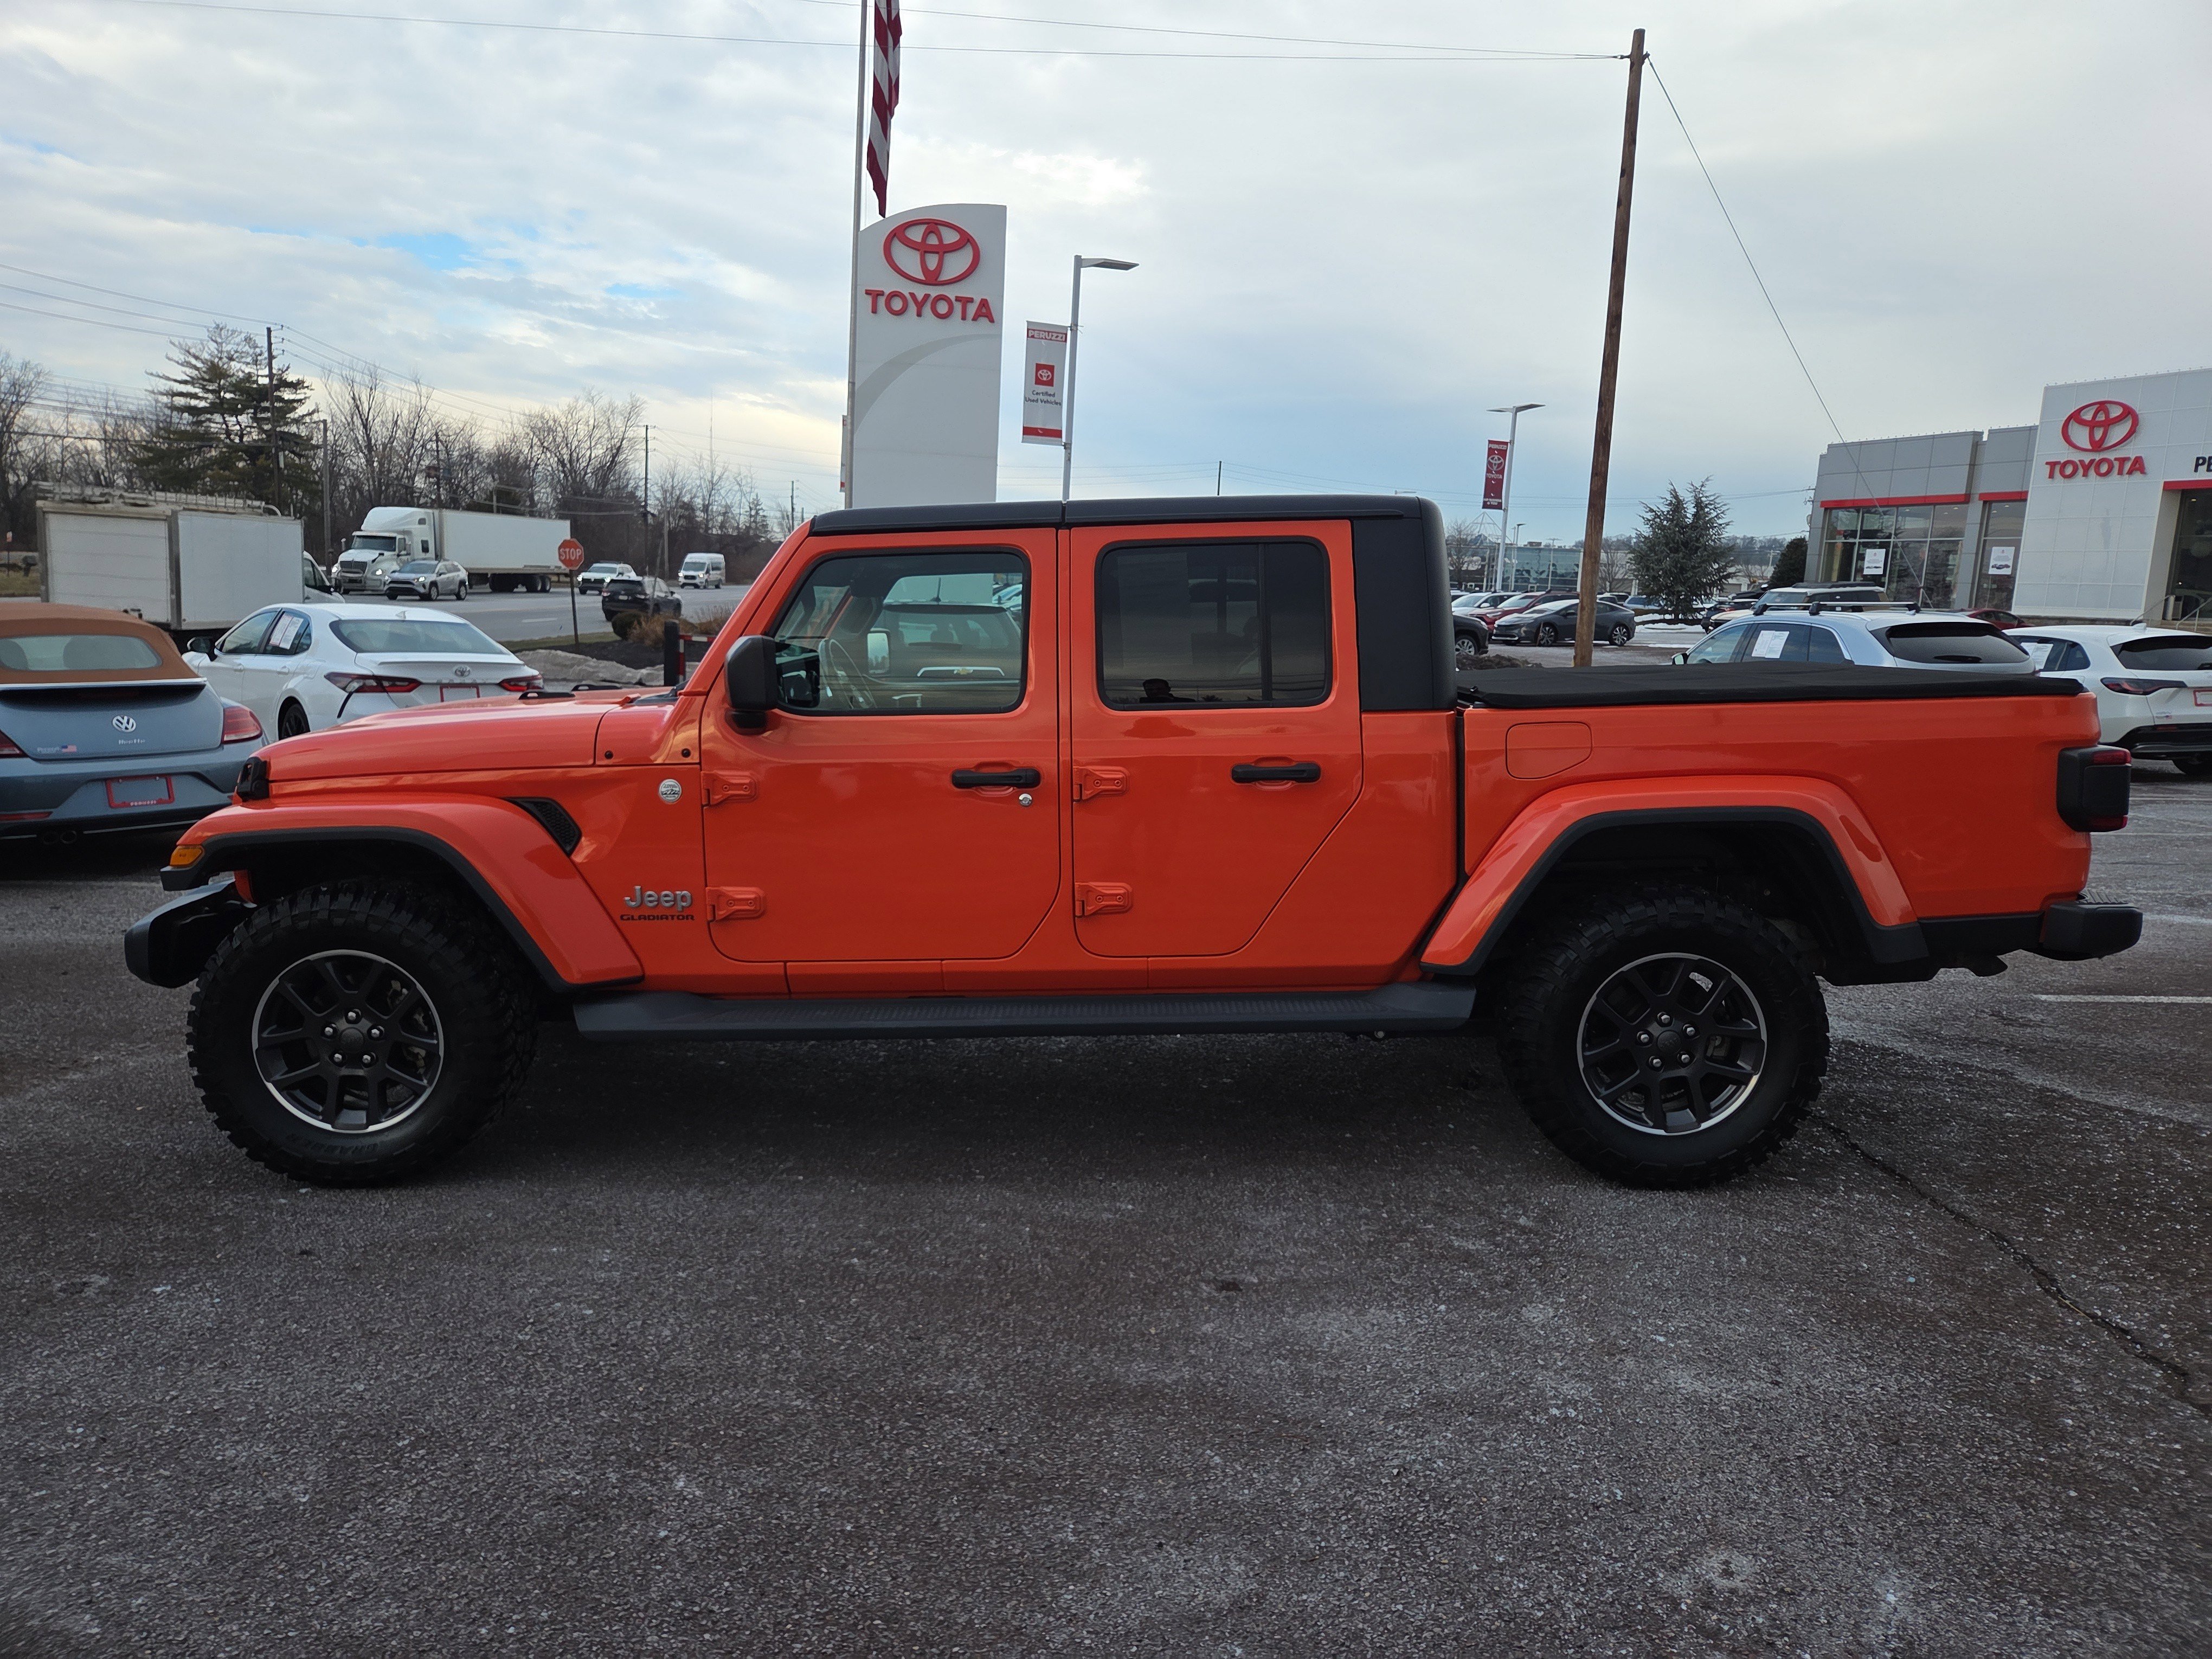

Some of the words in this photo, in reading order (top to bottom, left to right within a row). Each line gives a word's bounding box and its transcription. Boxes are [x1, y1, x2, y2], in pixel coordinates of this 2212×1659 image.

[865, 289, 995, 323] TOYOTA
[1028, 330, 1066, 342] PERUZZI
[1032, 389, 1056, 398] Certified
[1040, 398, 1062, 406] Vehicles
[2045, 455, 2146, 479] TOYOTA
[560, 548, 582, 560] STOP
[623, 885, 692, 911] Jeep
